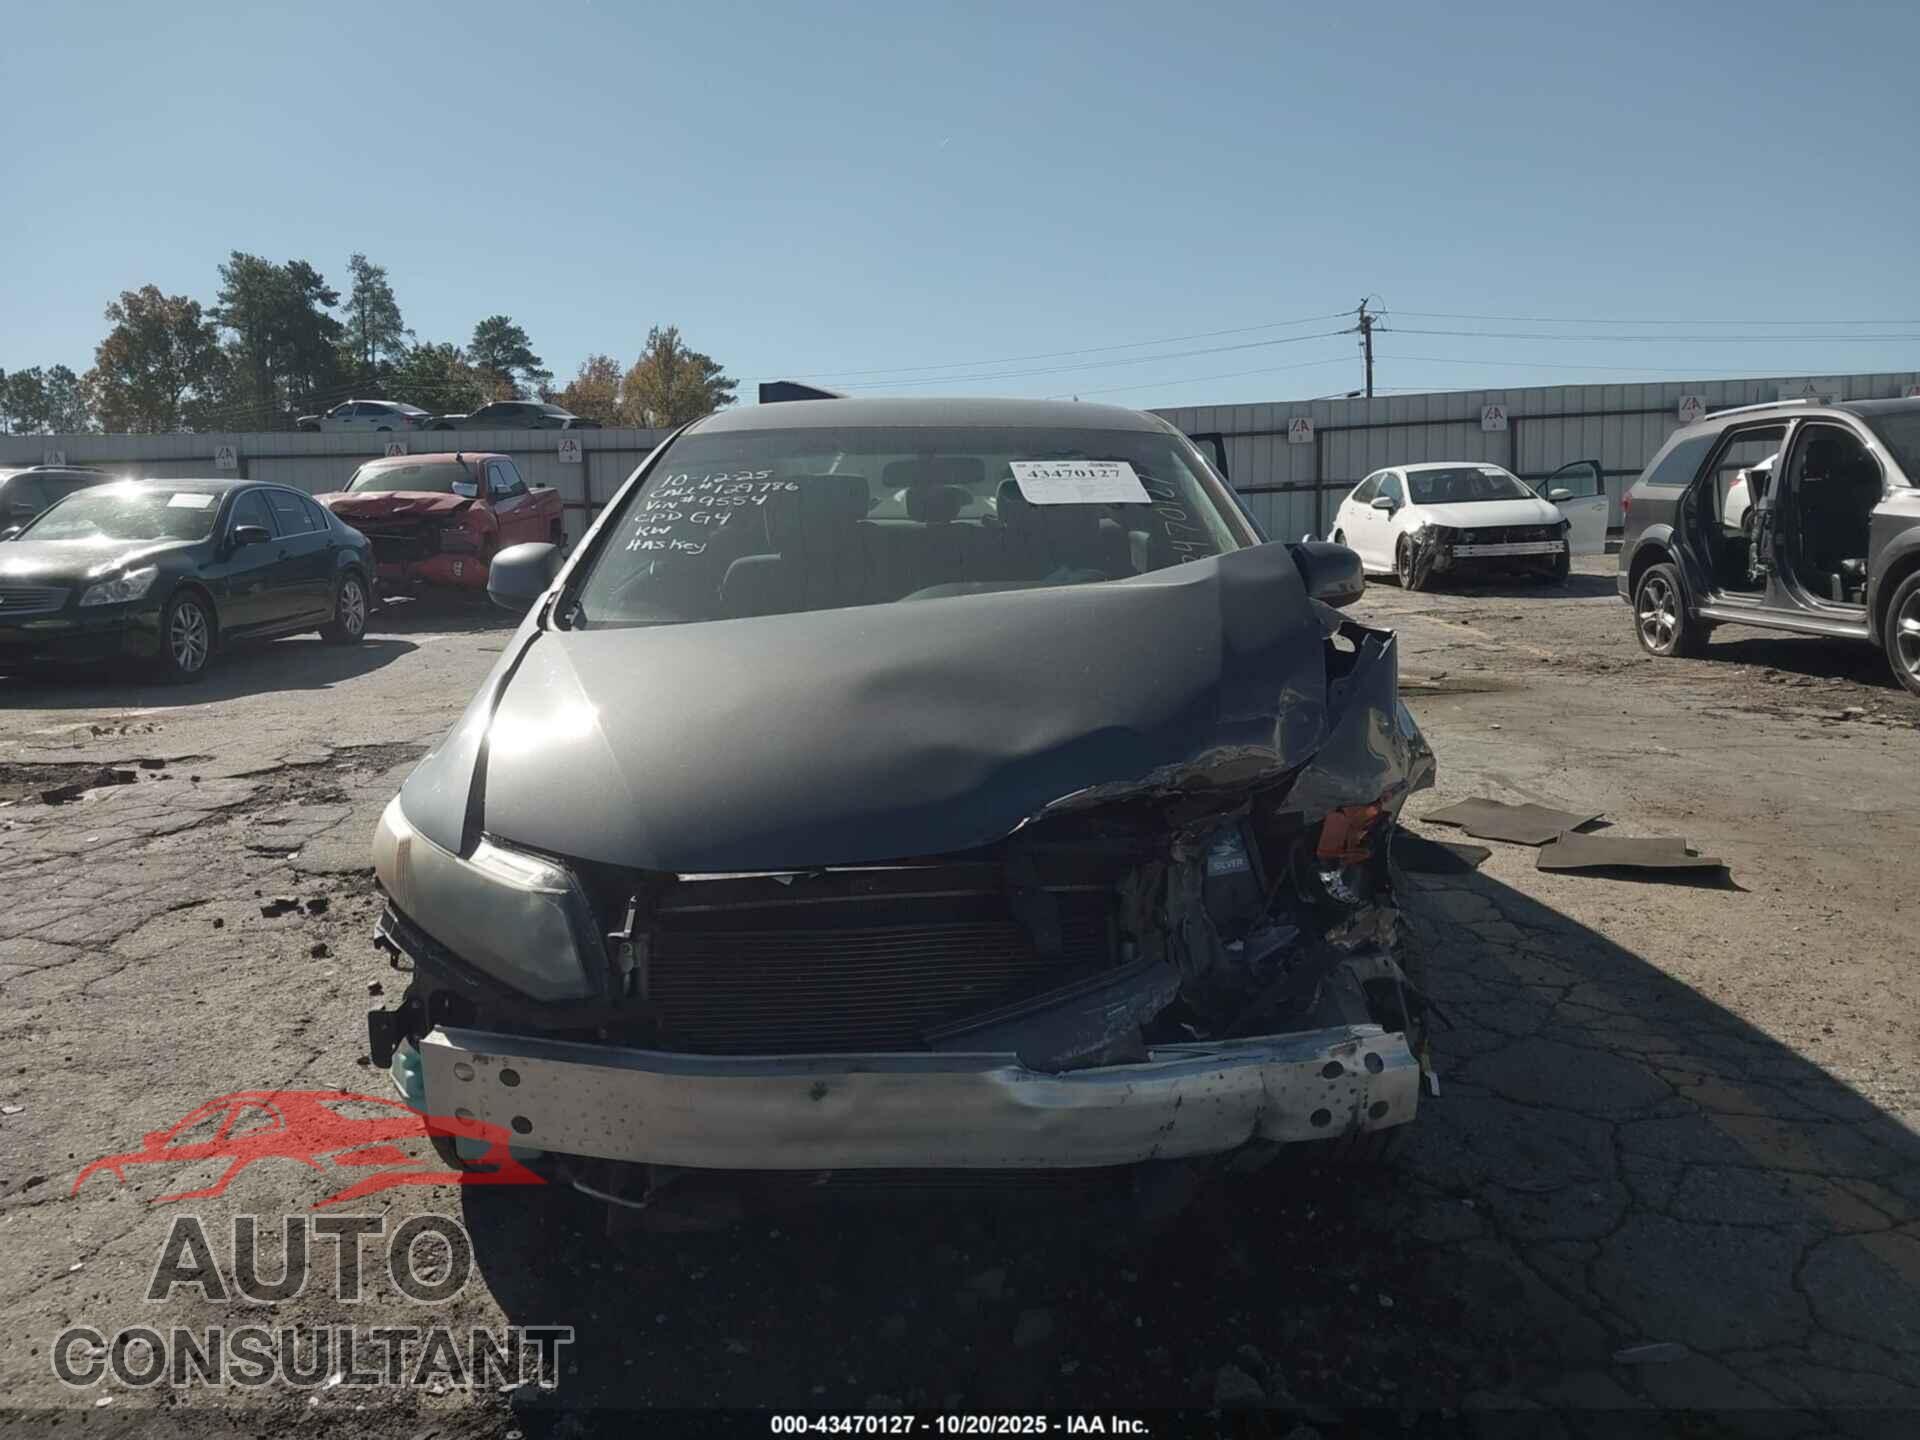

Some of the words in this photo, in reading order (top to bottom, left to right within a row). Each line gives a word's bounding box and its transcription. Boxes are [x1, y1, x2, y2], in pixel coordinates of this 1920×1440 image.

[1027, 469, 1120, 479] 43470127
[635, 511, 683, 524] CPD
[635, 525, 672, 537] KW
